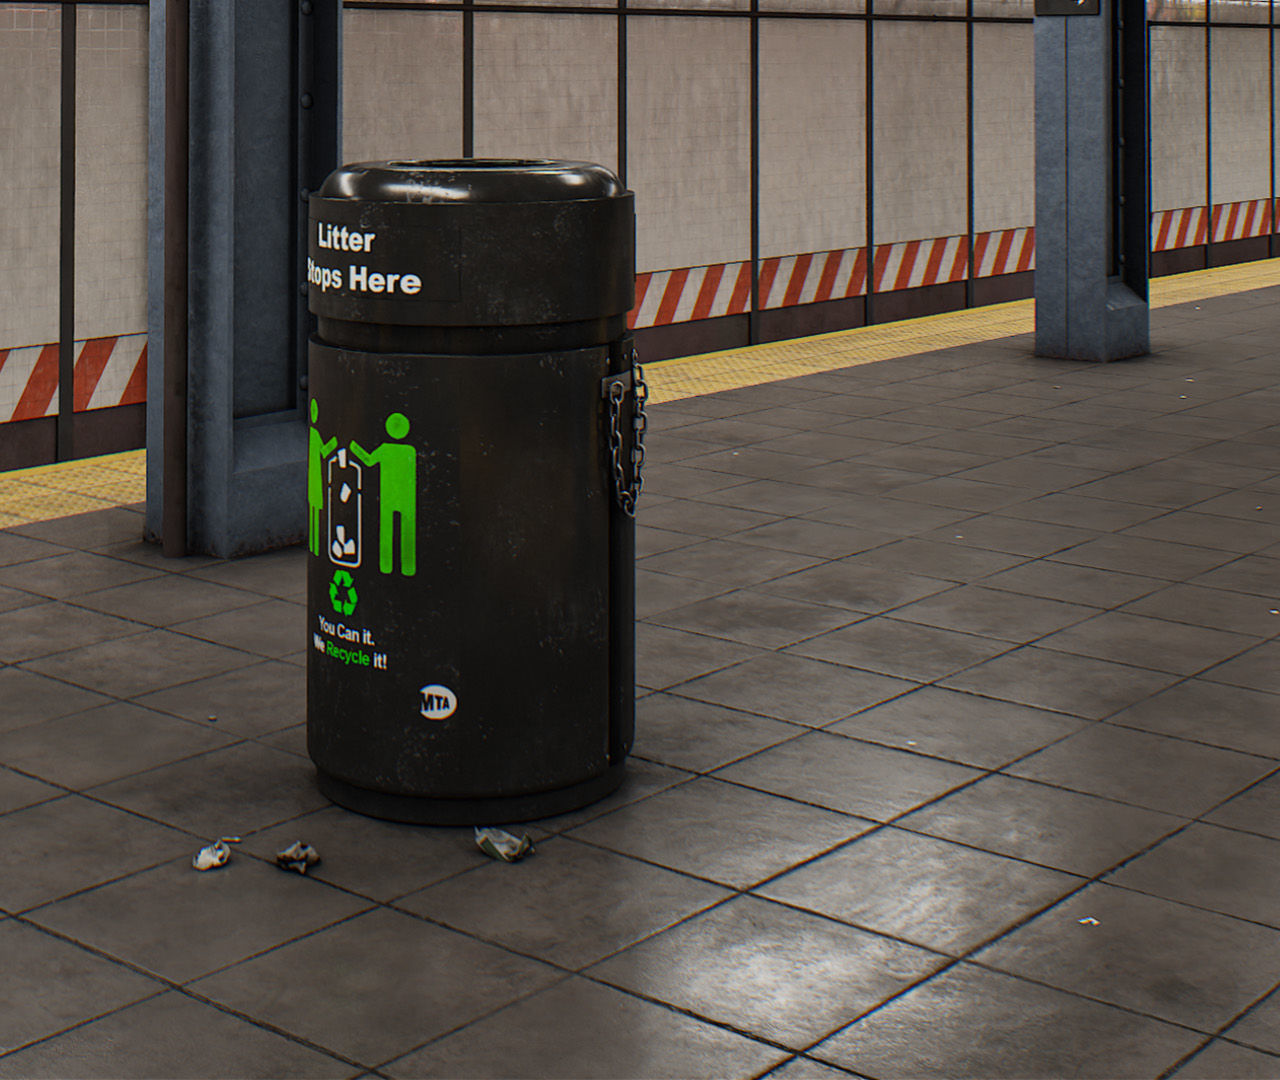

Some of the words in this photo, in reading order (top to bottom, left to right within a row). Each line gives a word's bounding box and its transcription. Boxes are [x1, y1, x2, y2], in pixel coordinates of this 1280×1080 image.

[318, 222, 376, 253] Litter
[348, 264, 422, 295] Here
[318, 615, 335, 637] You
[337, 622, 360, 644] Can
[363, 628, 376, 647] it.
[326, 640, 370, 667] Recycle
[372, 651, 388, 671] it!
[420, 692, 450, 712] MTA
